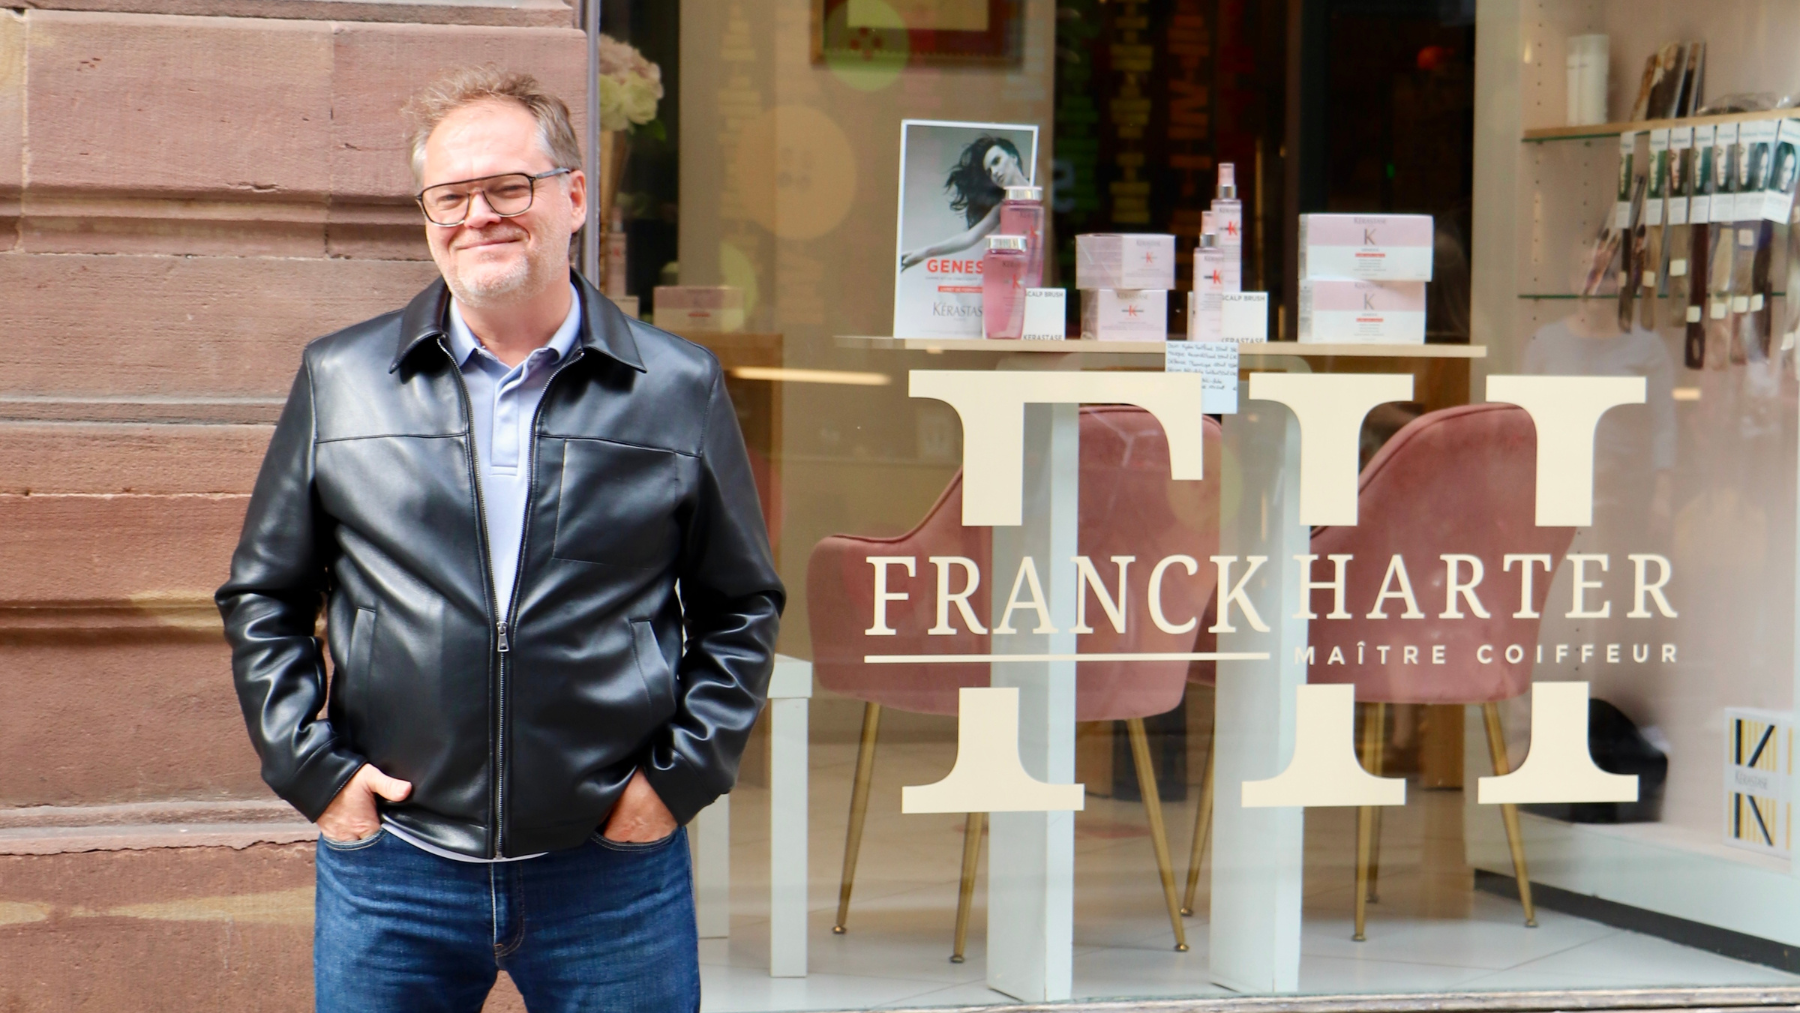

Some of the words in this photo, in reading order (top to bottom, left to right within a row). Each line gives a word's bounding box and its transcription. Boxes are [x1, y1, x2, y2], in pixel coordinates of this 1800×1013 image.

[1363, 228, 1377, 246] K
[926, 258, 983, 275] GENES
[932, 301, 983, 318] KÉRASTAS
[1363, 293, 1375, 311] K
[864, 553, 1272, 636] FRANCK
[1291, 553, 1679, 620] HARTER
[1293, 641, 1447, 666] MAÎTRE
[1475, 643, 1679, 665] COIFFEUR
